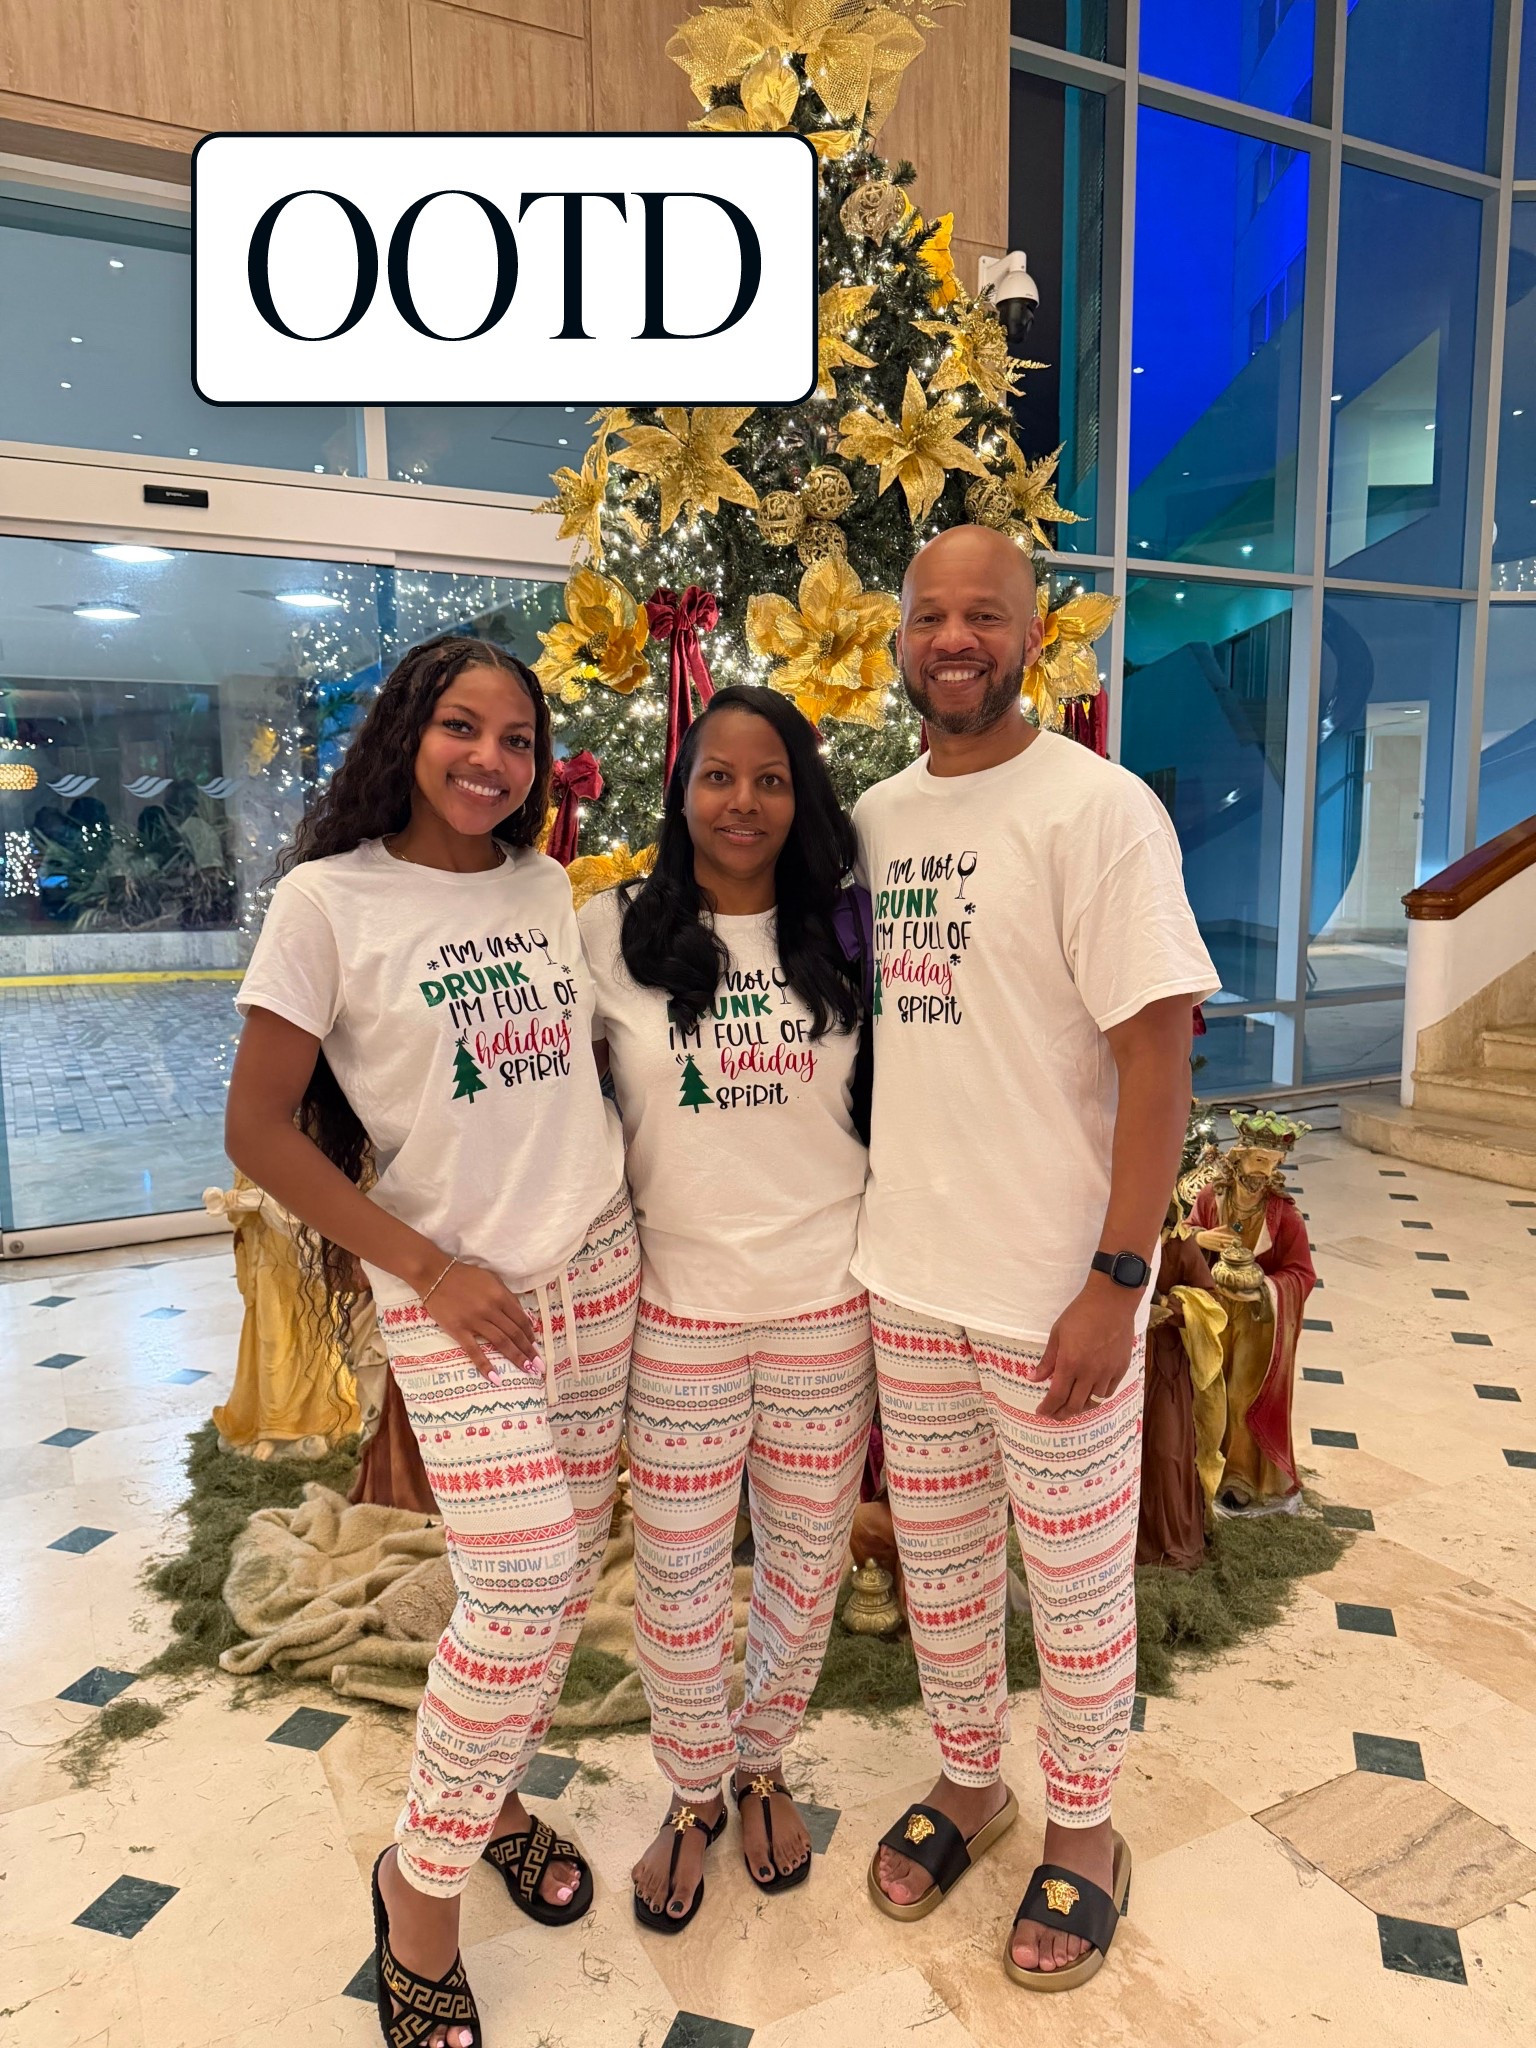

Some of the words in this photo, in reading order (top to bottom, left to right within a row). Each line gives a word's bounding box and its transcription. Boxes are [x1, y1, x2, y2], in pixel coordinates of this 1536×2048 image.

[921, 853, 955, 882] not
[487, 933, 532, 958] not
[875, 922, 894, 950] I'M
[903, 921, 944, 950] FULL
[947, 921, 972, 950] OF
[419, 961, 530, 1007] DRUNK
[882, 949, 953, 996] holiday
[449, 996, 485, 1029] I'M
[493, 985, 547, 1019] FULL
[553, 979, 578, 1006] OF
[666, 993, 773, 1023] UNK
[475, 1018, 572, 1069] holiday
[714, 1021, 769, 1049] FULL
[780, 1019, 808, 1043] OF
[720, 1042, 818, 1083] holiday
[432, 1372, 451, 1386] LET
[453, 1369, 465, 1382] IT
[606, 1365, 622, 1380] LET
[780, 1375, 801, 1385] LET
[803, 1376, 814, 1386] IT
[815, 1371, 846, 1386] SNOW
[642, 1379, 672, 1394] SNOW
[675, 1385, 698, 1396] LET
[699, 1385, 710, 1396] IT
[712, 1380, 741, 1395] SNOW
[884, 1394, 912, 1409] SNOW
[914, 1402, 935, 1411] LET
[937, 1402, 948, 1411] IT
[1020, 1431, 1052, 1446] SNOW
[1053, 1436, 1077, 1448] LET
[1078, 1433, 1089, 1445] IT
[1090, 1420, 1118, 1440] SNOW
[785, 1510, 803, 1523] LET
[804, 1515, 812, 1527] IT
[812, 1521, 835, 1532] SNO
[668, 1554, 691, 1568] LET
[692, 1550, 703, 1564] IT
[703, 1534, 726, 1559] SNOW
[899, 1533, 928, 1548] SNOW
[930, 1537, 950, 1547] LET
[952, 1534, 961, 1544] IT
[467, 1558, 483, 1572] LET
[485, 1560, 496, 1573] IT
[498, 1557, 542, 1573] SNOW
[544, 1551, 566, 1570] LET
[1065, 1580, 1086, 1593] LET
[1088, 1574, 1099, 1587] IT
[1098, 1561, 1123, 1582] SNOW
[921, 1662, 949, 1677] SNOW
[951, 1669, 970, 1678] LET
[672, 1687, 692, 1696] LET
[694, 1687, 704, 1696] IT
[705, 1681, 724, 1694] SNO
[1084, 1712, 1104, 1721] LET
[1105, 1705, 1114, 1717] IT
[1113, 1693, 1134, 1710] SNO
[435, 1726, 453, 1742] LET
[453, 1738, 464, 1751] IT
[466, 1735, 501, 1755] SNOW
